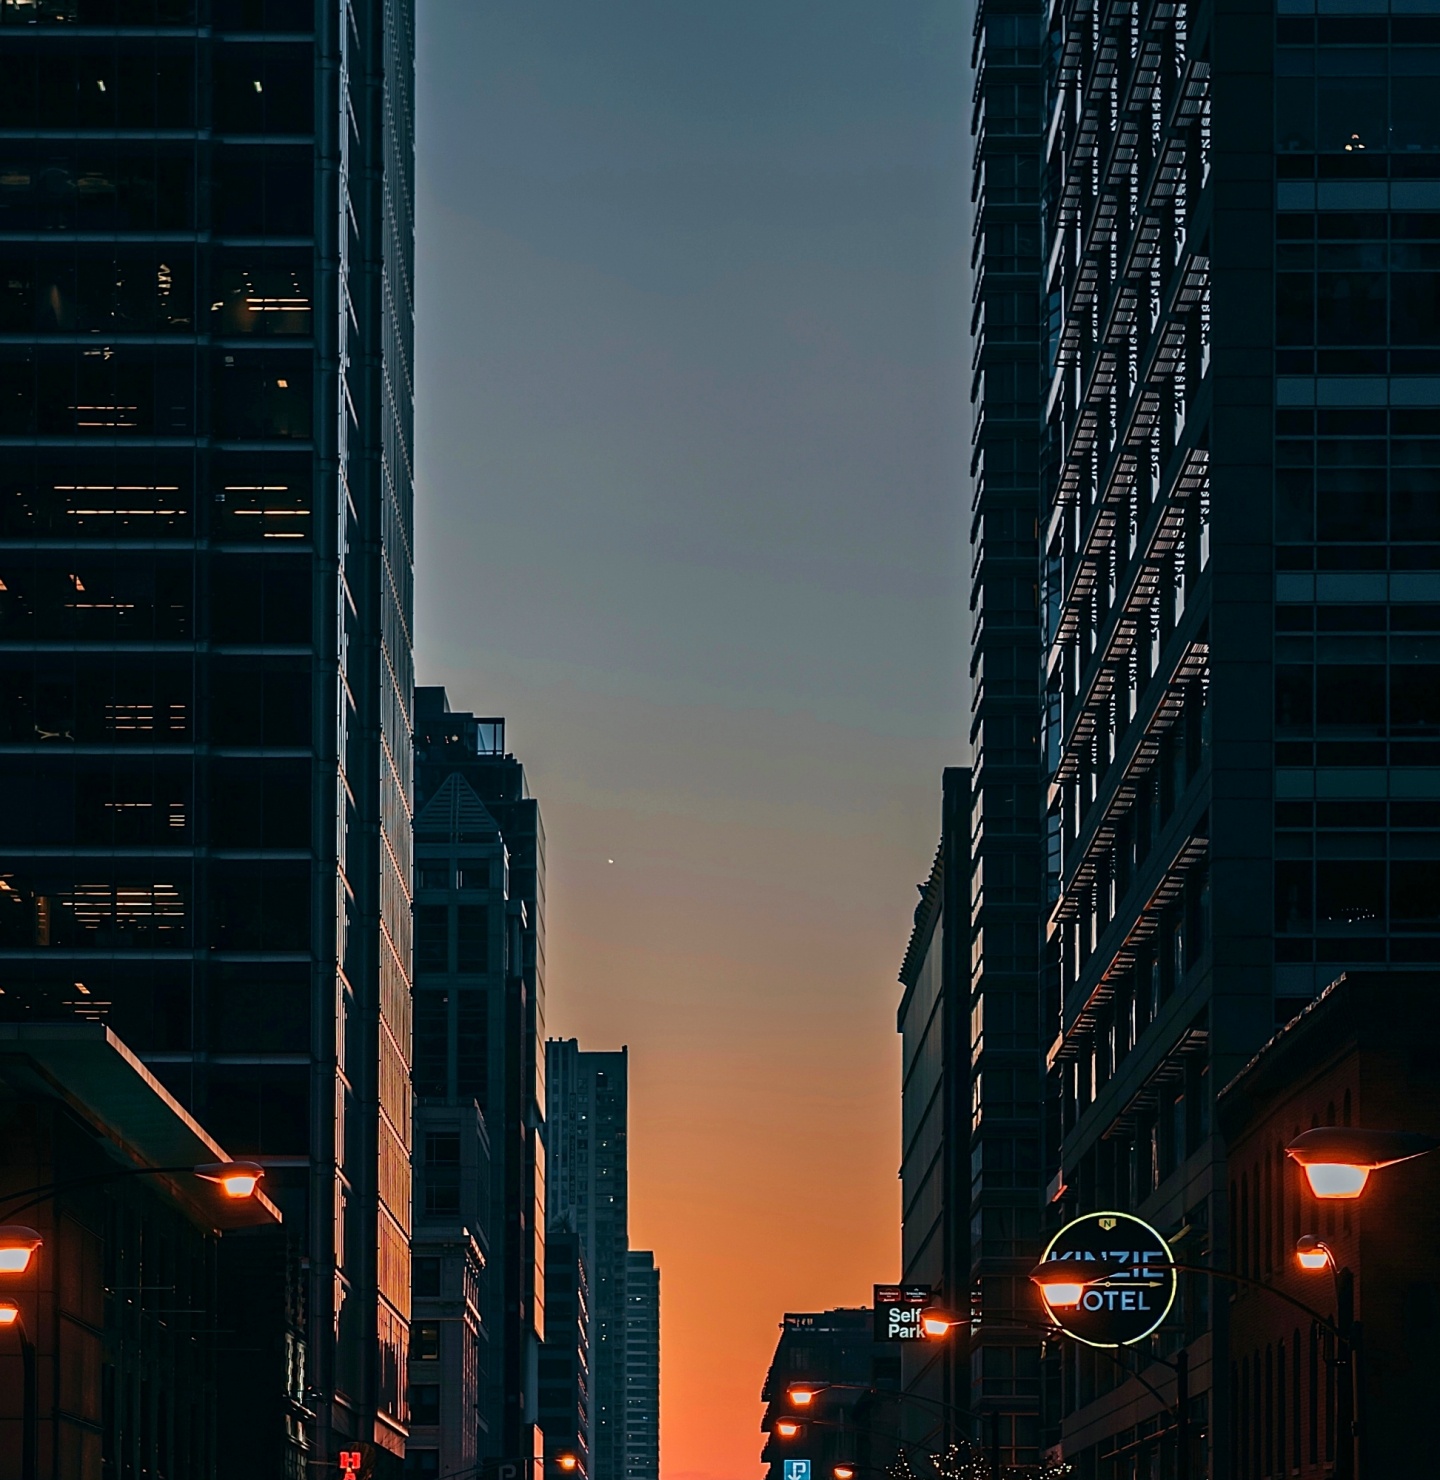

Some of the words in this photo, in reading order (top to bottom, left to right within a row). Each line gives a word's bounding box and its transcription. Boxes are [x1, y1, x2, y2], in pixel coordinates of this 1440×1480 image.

[1064, 1290, 1151, 1312] OTEL
[888, 1307, 922, 1323] Self
[888, 1324, 926, 1338] Park
